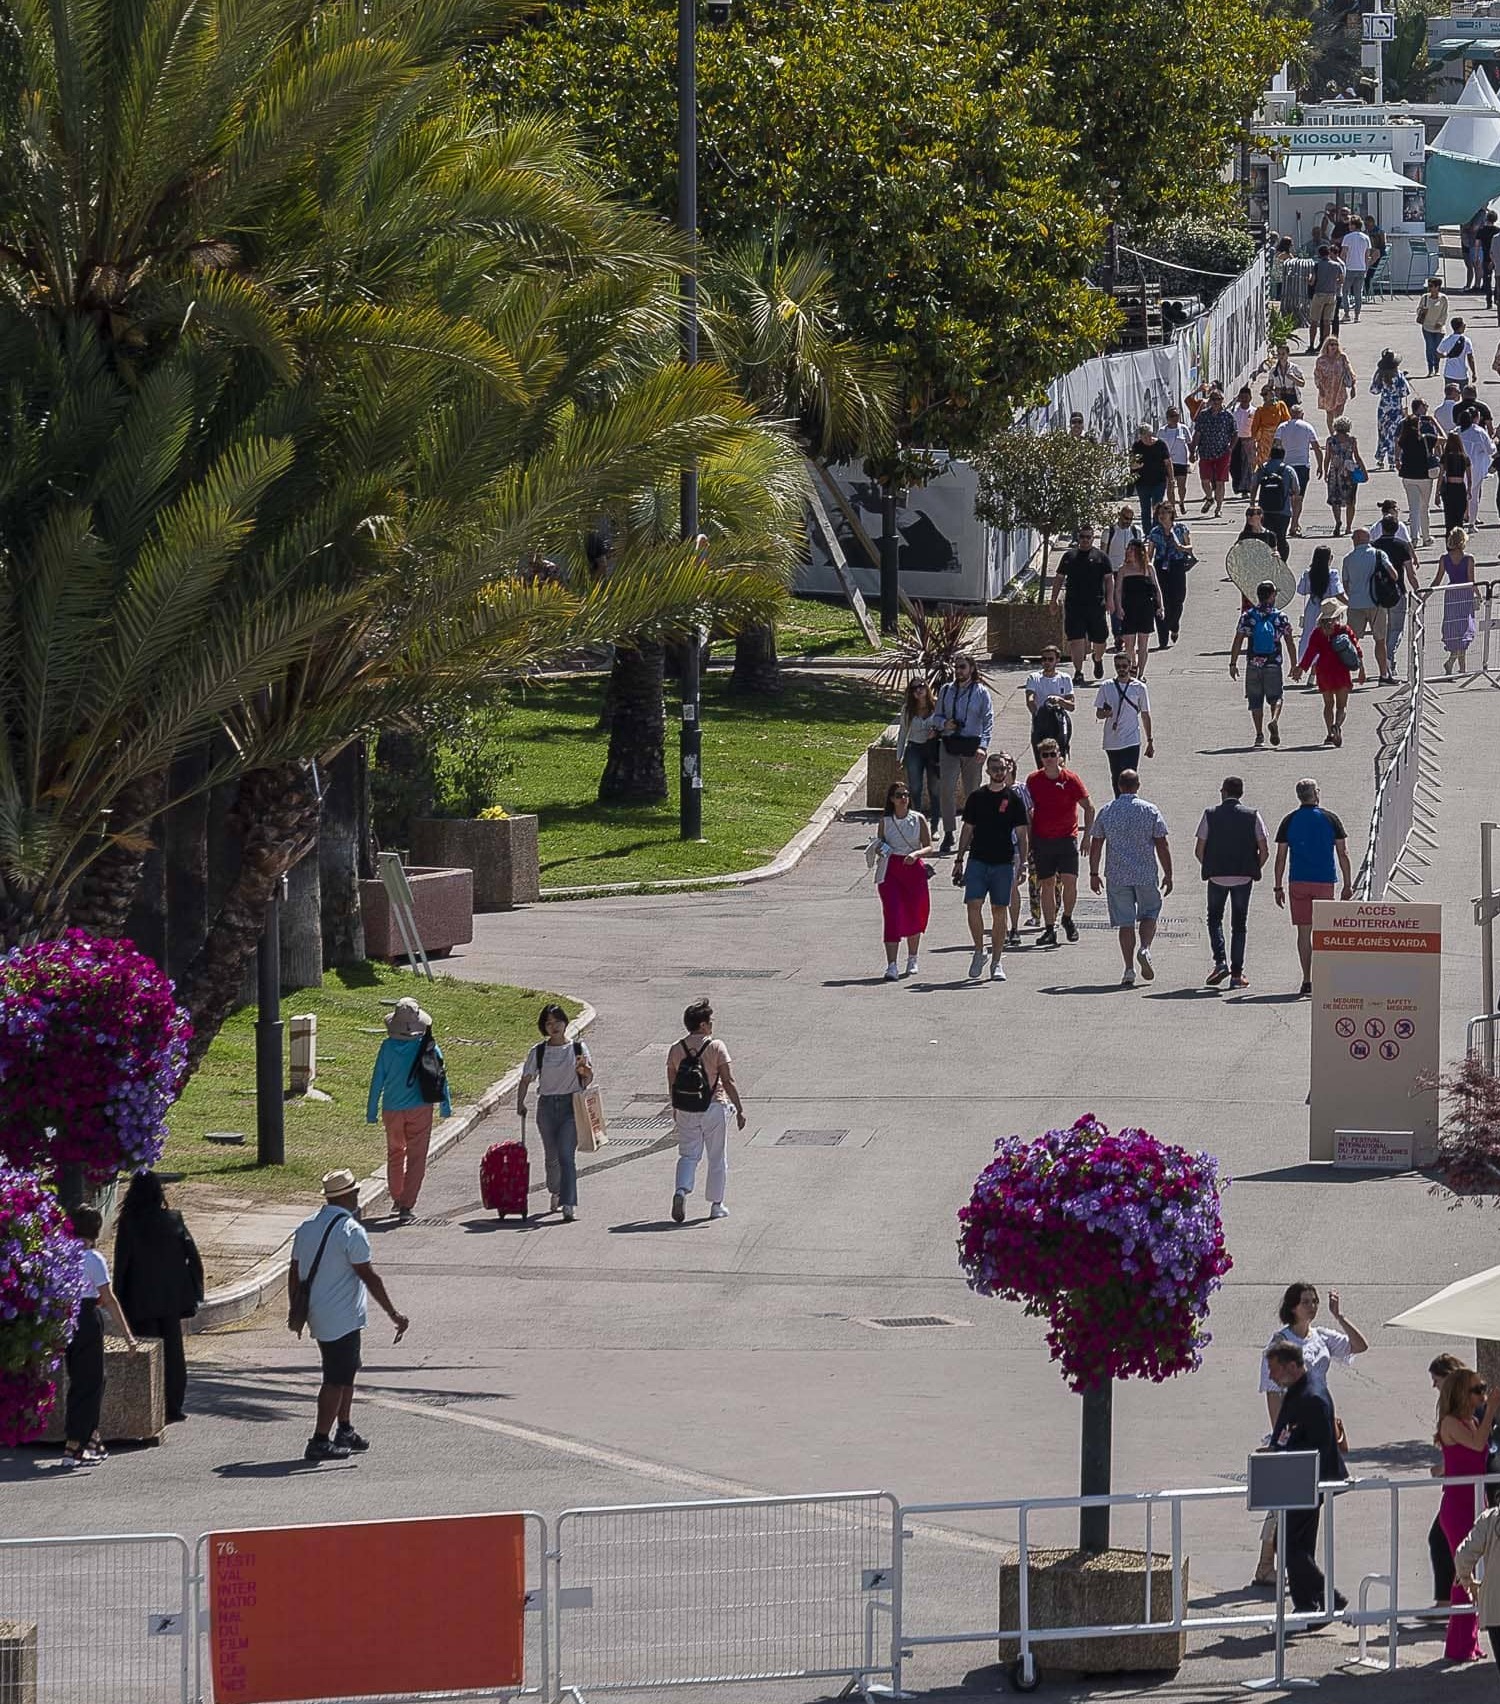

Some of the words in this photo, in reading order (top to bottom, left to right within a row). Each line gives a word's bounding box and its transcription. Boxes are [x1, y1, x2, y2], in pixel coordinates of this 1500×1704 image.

[1293, 133, 1362, 145] KIOSQUE
[1367, 133, 1376, 144] 7
[1414, 132, 1420, 150] 7
[1333, 917, 1420, 930] MÉDITERRANÉE
[1323, 937, 1355, 946] SALLE
[1392, 938, 1427, 948] VARDA
[216, 1541, 239, 1555] 76.
[217, 1554, 256, 1567] FESTI
[218, 1570, 242, 1582] VAL
[218, 1582, 257, 1596] INTER
[218, 1596, 257, 1609] NATIO
[219, 1625, 239, 1638] DU
[220, 1638, 249, 1650] FILM
[220, 1651, 240, 1665] DE
